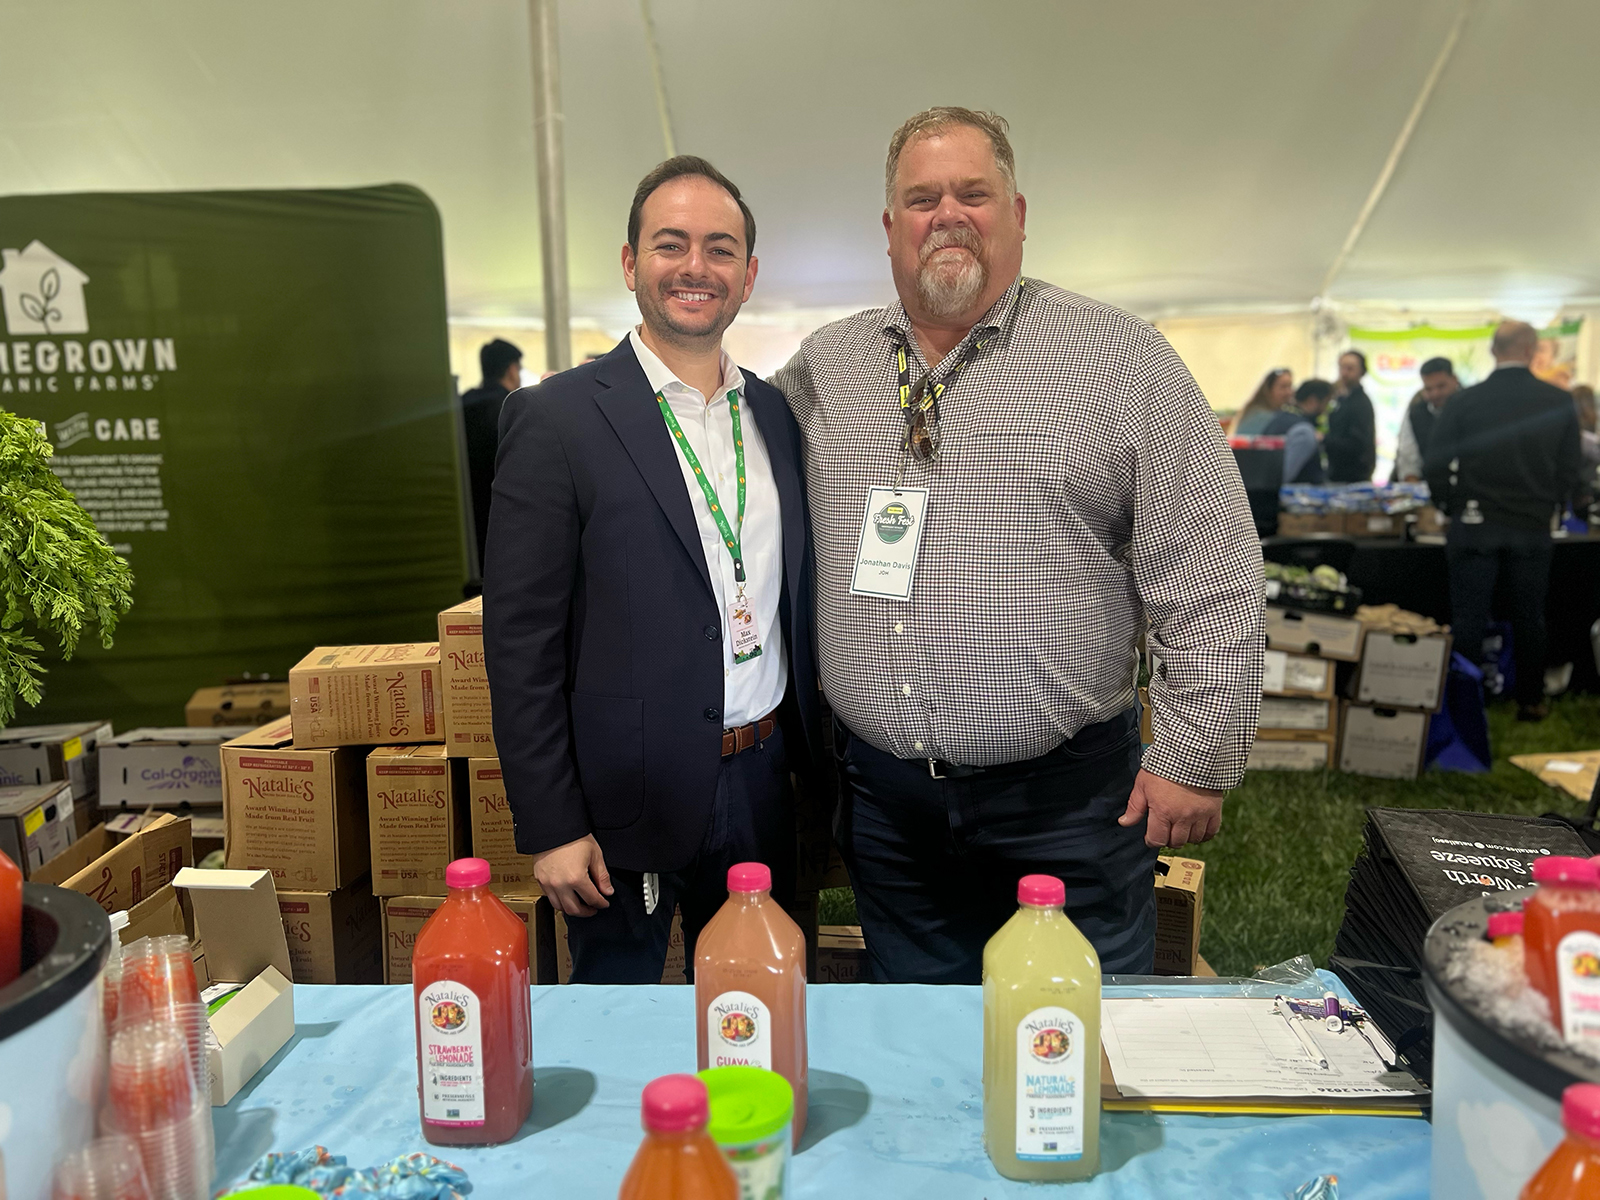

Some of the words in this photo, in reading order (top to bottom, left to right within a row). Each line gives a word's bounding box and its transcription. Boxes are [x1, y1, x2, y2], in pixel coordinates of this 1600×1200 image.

[2, 377, 58, 392] ANIC
[94, 418, 160, 441] CARE
[873, 512, 896, 525] Fresh
[898, 514, 915, 526] Fest
[860, 558, 891, 568] Jonathan
[892, 562, 910, 570] Davis
[740, 630, 751, 638] Max
[473, 735, 491, 743] USA
[141, 768, 222, 783] Cal-Organi
[268, 806, 296, 814] Winning
[158, 852, 166, 877] STACK
[1430, 850, 1526, 874] Squeeze
[1442, 869, 1517, 890] Worth
[428, 1044, 472, 1055] STRAWBERRY
[435, 1052, 473, 1063] LEMONADE
[716, 1056, 749, 1067] GUAVA
[1026, 1075, 1068, 1087] NATURAL
[1034, 1081, 1075, 1094] LEMONADE
[1029, 1109, 1035, 1119] 3
